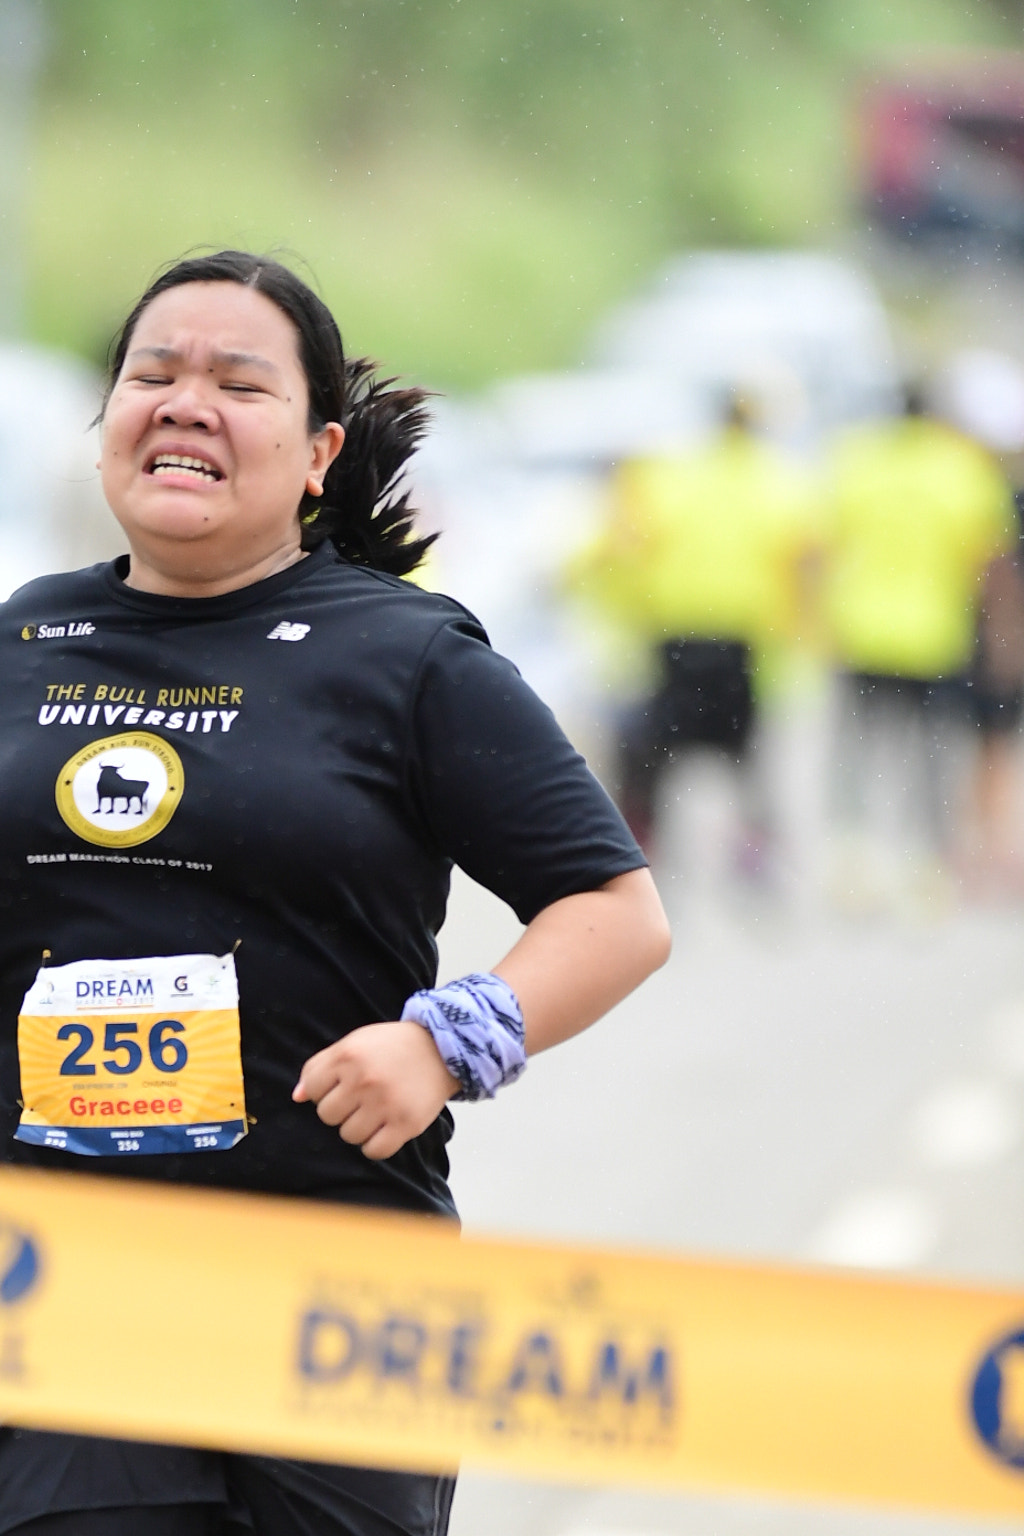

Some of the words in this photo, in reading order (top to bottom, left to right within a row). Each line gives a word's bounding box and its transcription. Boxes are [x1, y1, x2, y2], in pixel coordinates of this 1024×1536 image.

[37, 624, 66, 639] Sun
[67, 622, 96, 637] Life
[45, 684, 86, 701] THE
[94, 685, 146, 705] BULL
[156, 686, 244, 707] RUNNER
[37, 705, 239, 733] UNIVERSITY
[27, 854, 67, 864] DREAM
[69, 854, 130, 864] MARATHON
[132, 857, 166, 866] CLASS
[76, 978, 154, 998] DREAM
[57, 1020, 188, 1075] 256
[69, 1096, 183, 1116] Graceee
[117, 1140, 140, 1151] 256
[193, 1136, 218, 1148] 256
[295, 1306, 676, 1425] DREAM
